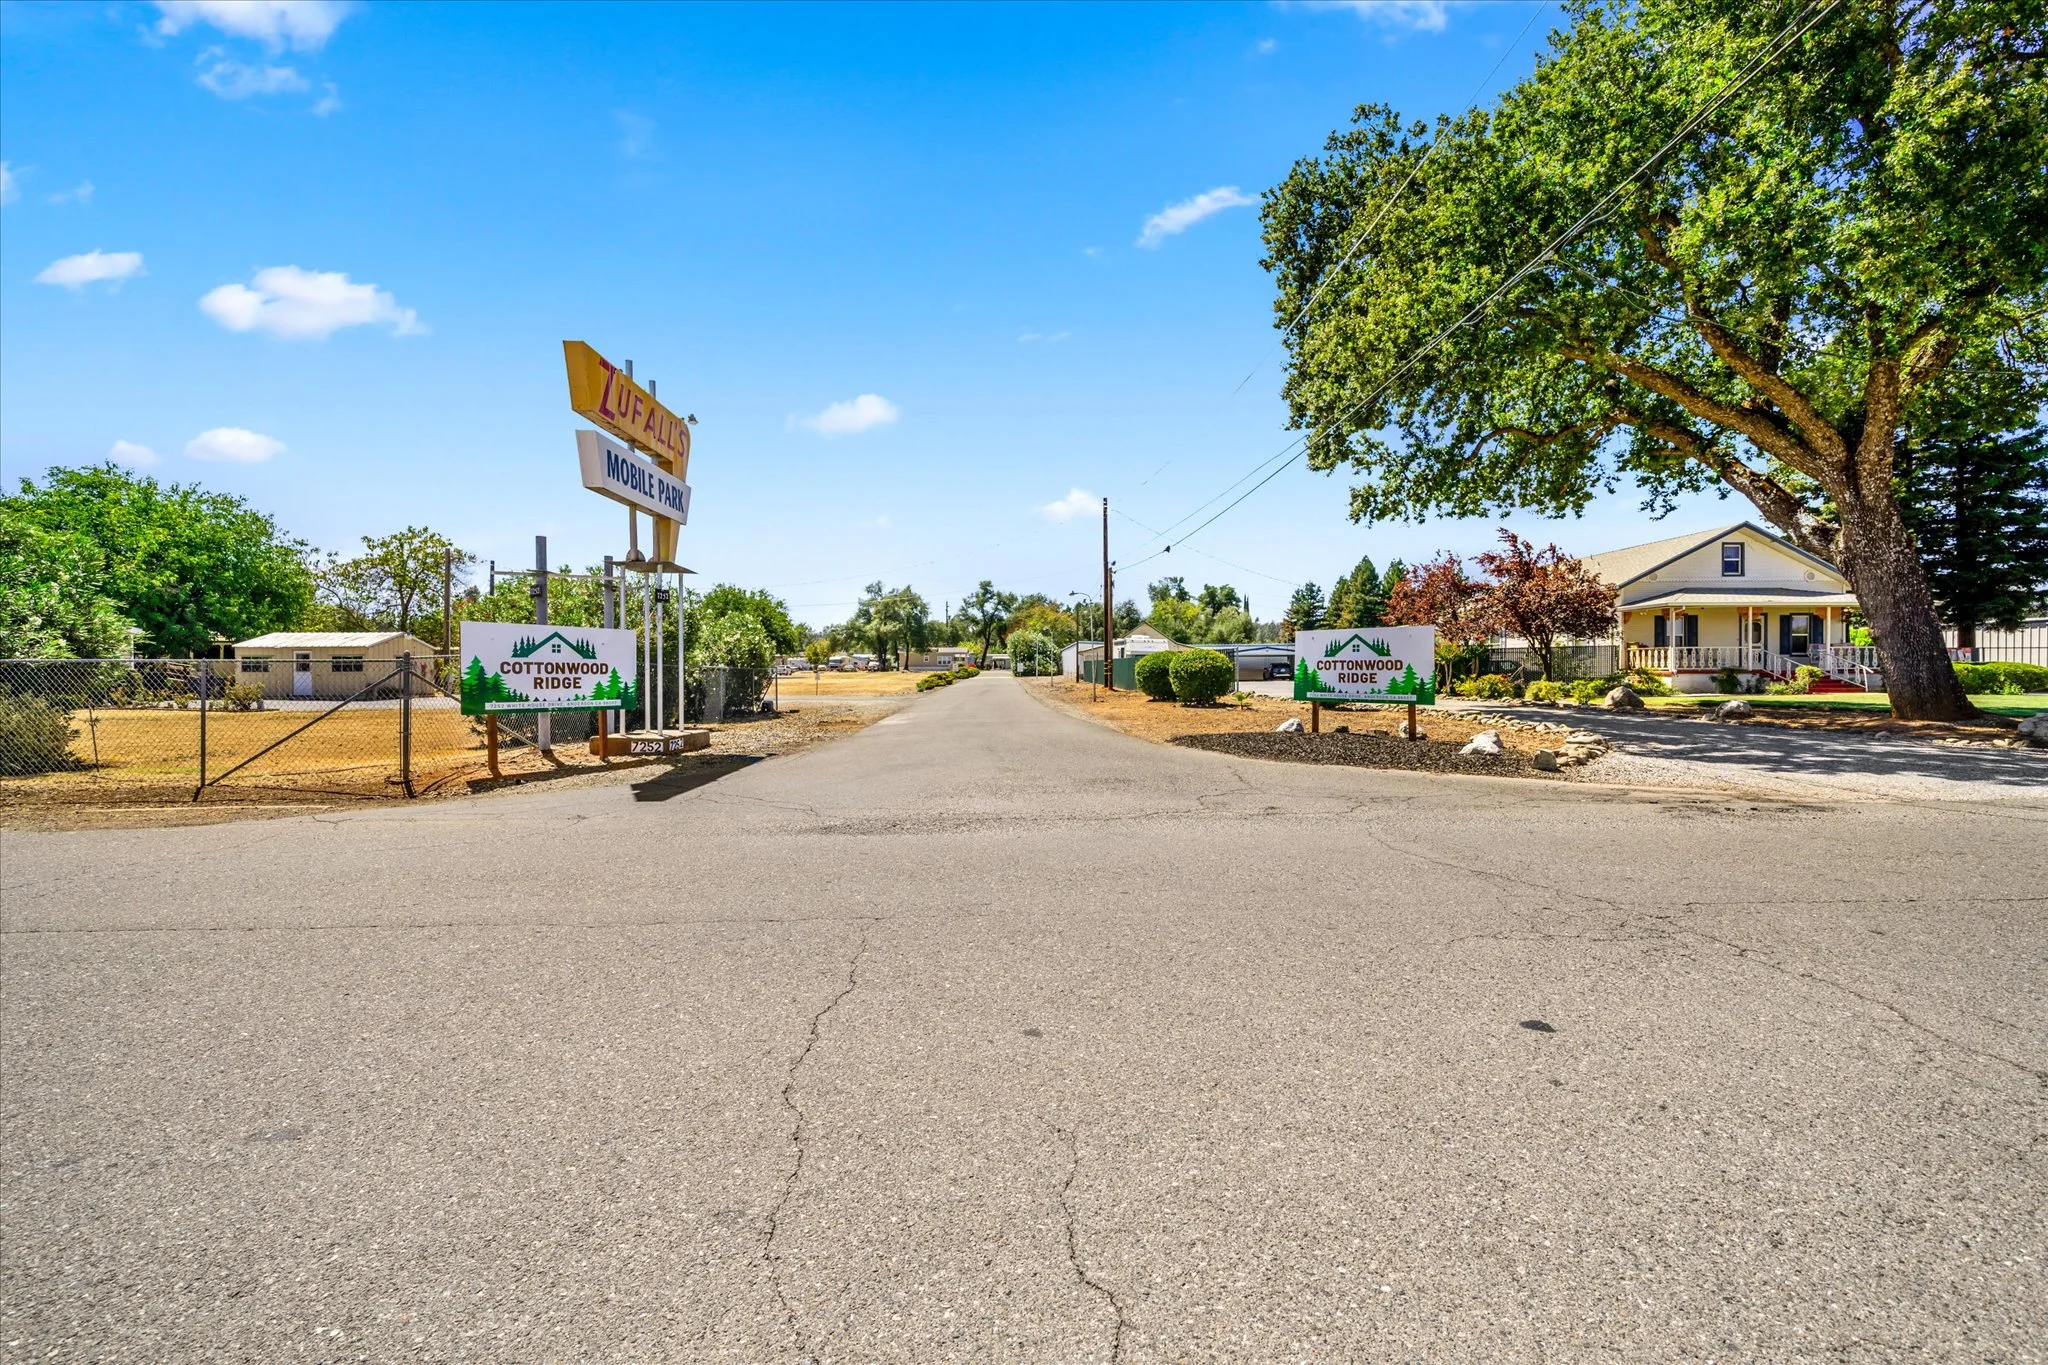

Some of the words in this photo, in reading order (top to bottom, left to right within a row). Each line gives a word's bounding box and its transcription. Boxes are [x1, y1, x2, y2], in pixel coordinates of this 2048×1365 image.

[599, 357, 687, 458] ZUFALL'S
[606, 449, 655, 500] MOBILE
[658, 477, 685, 514] PARK
[500, 661, 609, 675] COTTONWOOD
[1316, 660, 1404, 671] COTTONWOOD
[533, 677, 582, 690] RIDGE
[1338, 672, 1378, 684] RIDGE
[632, 742, 661, 752] 7252
